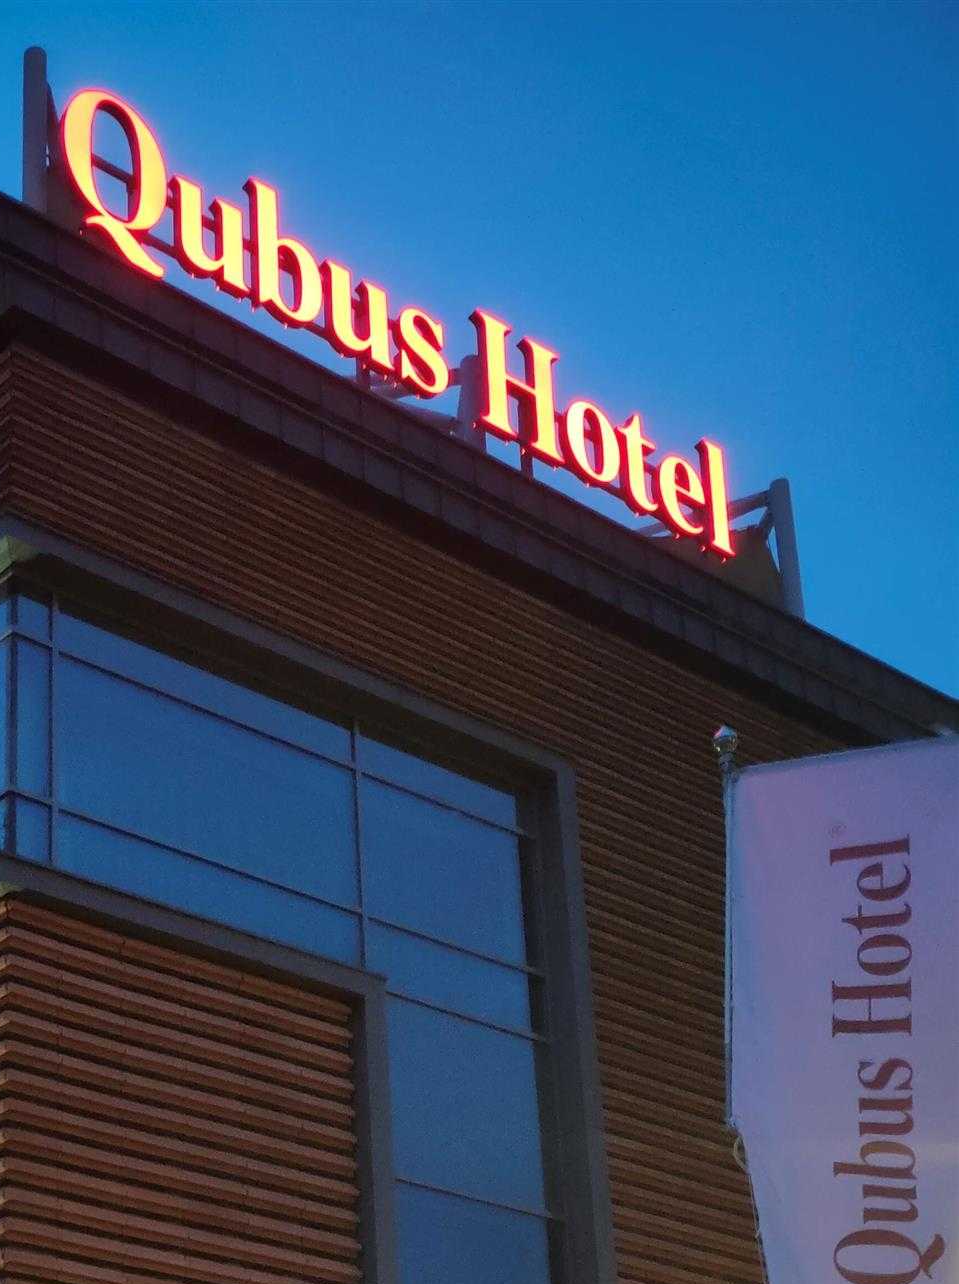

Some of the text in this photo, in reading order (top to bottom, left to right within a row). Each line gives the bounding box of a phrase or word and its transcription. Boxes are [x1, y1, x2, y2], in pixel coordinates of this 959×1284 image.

[61, 88, 736, 557] Qubus Hotel
[830, 834, 912, 1038] Hotel
